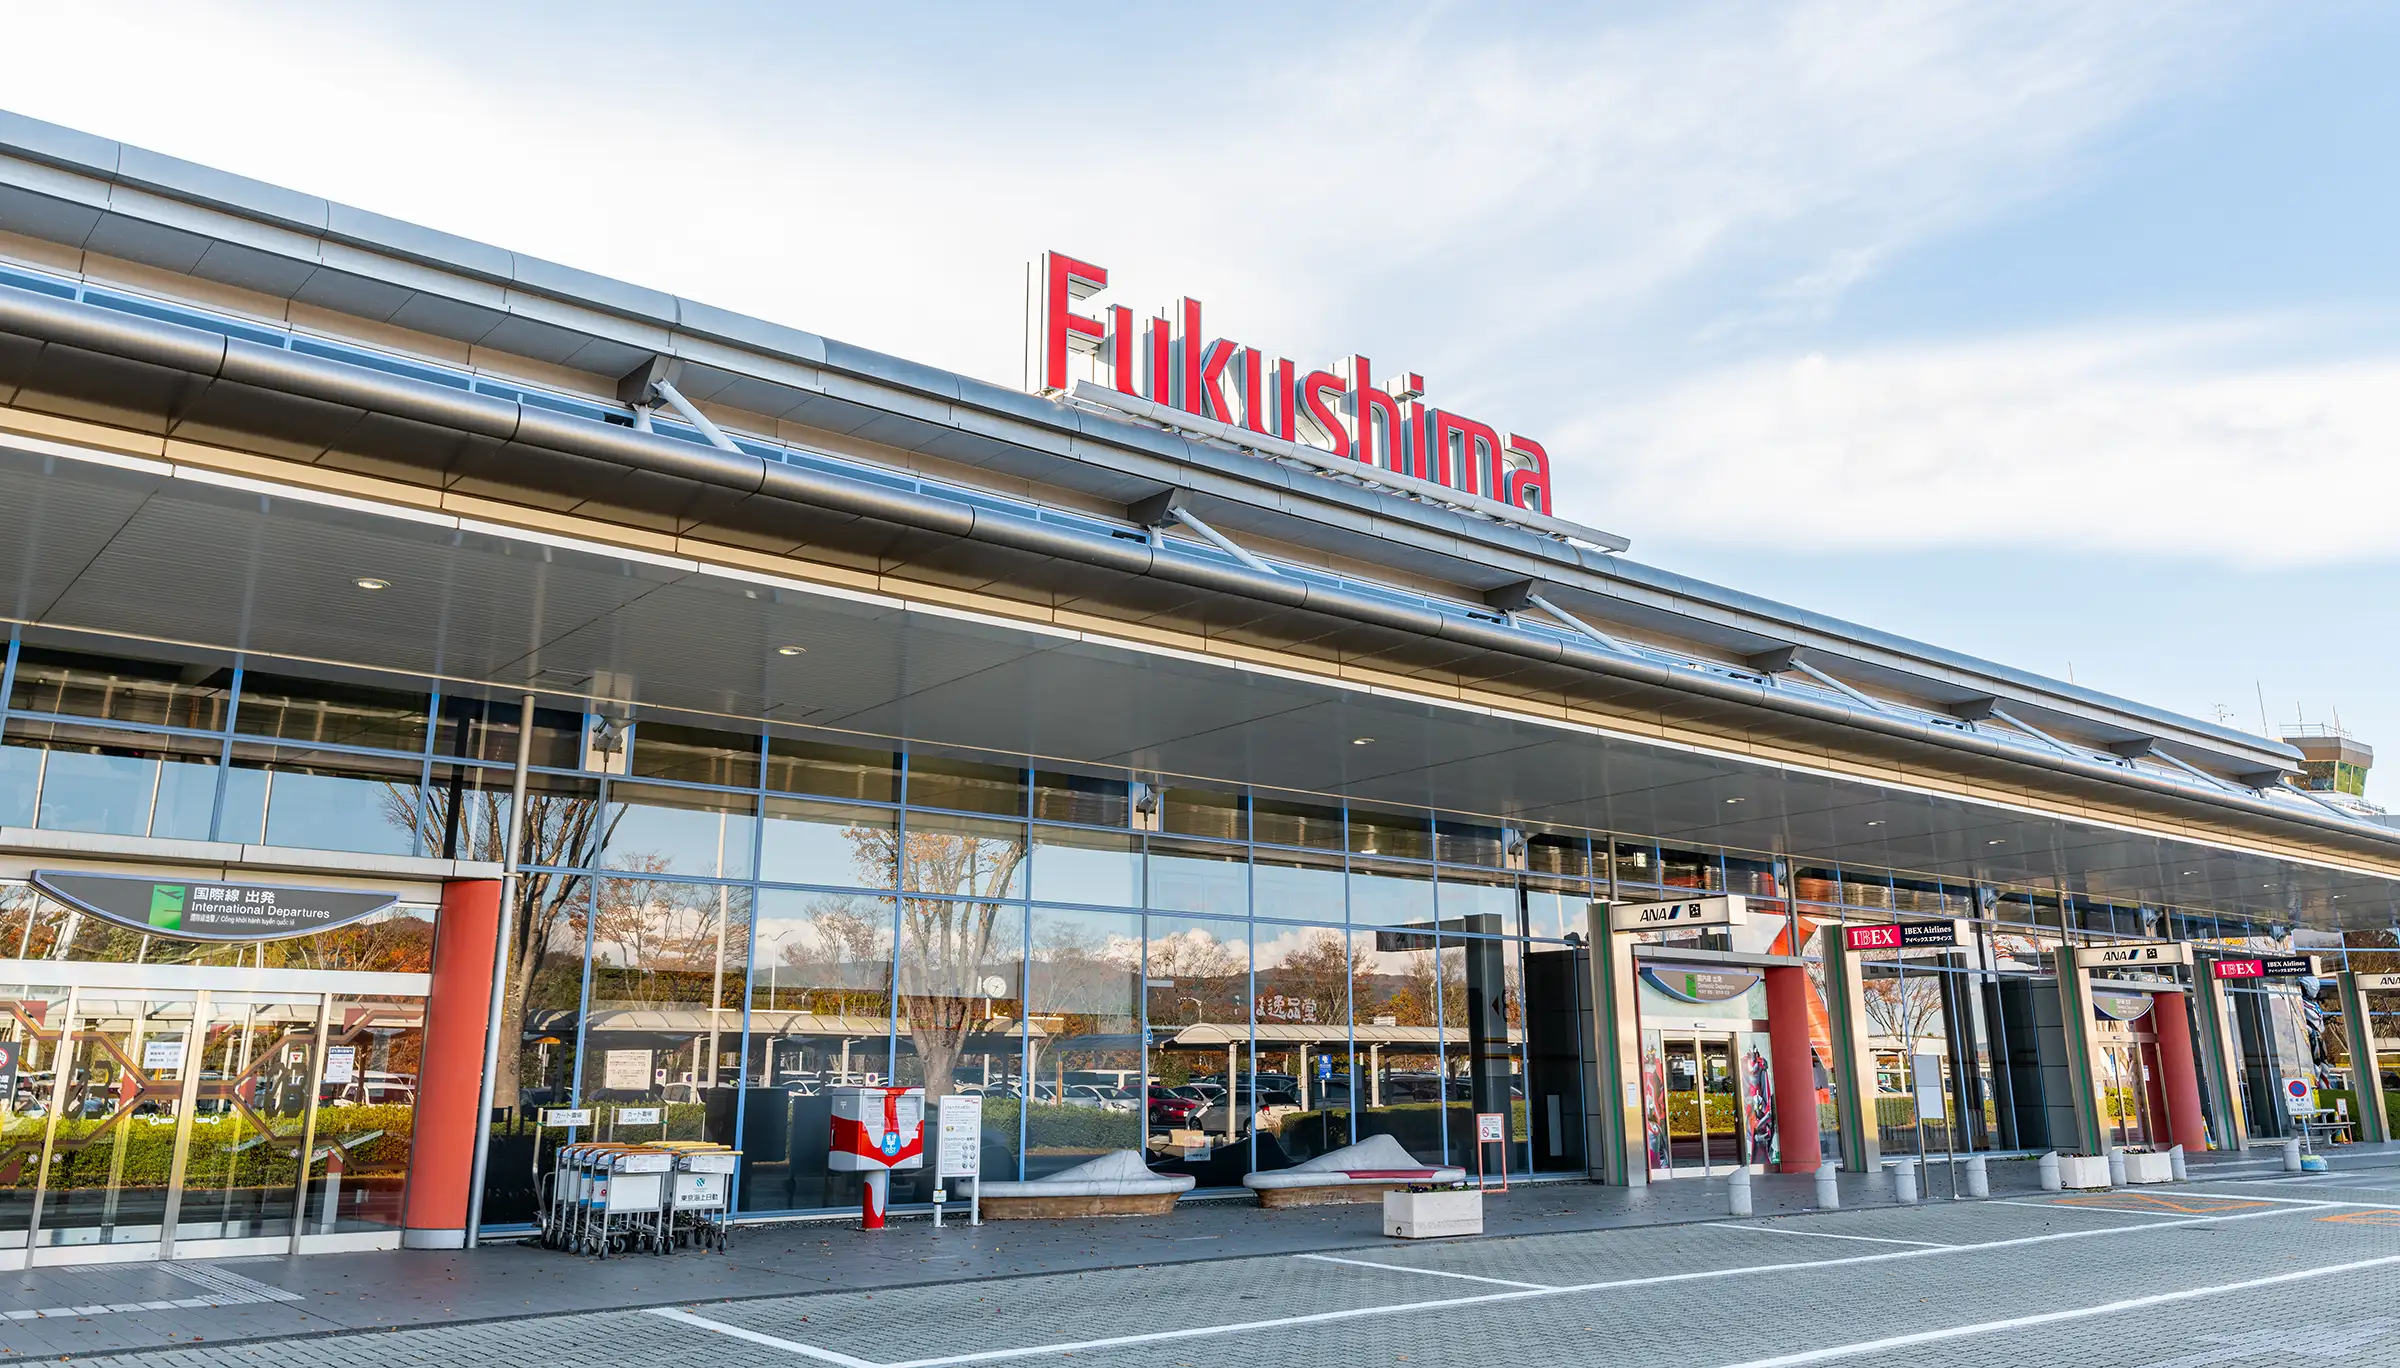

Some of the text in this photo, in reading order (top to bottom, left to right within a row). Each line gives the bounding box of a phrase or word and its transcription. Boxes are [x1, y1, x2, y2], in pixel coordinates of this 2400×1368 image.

[1047, 249, 1552, 517] Fukushima
[193, 887, 275, 904] 国際線 出発
[191, 901, 330, 919] International Departures
[1640, 907, 1667, 922] ANA
[1852, 929, 1894, 946] IBEX
[1904, 925, 1951, 935] IBEX Airlines
[2102, 951, 2127, 962] ANA
[2221, 963, 2255, 976] IBEX
